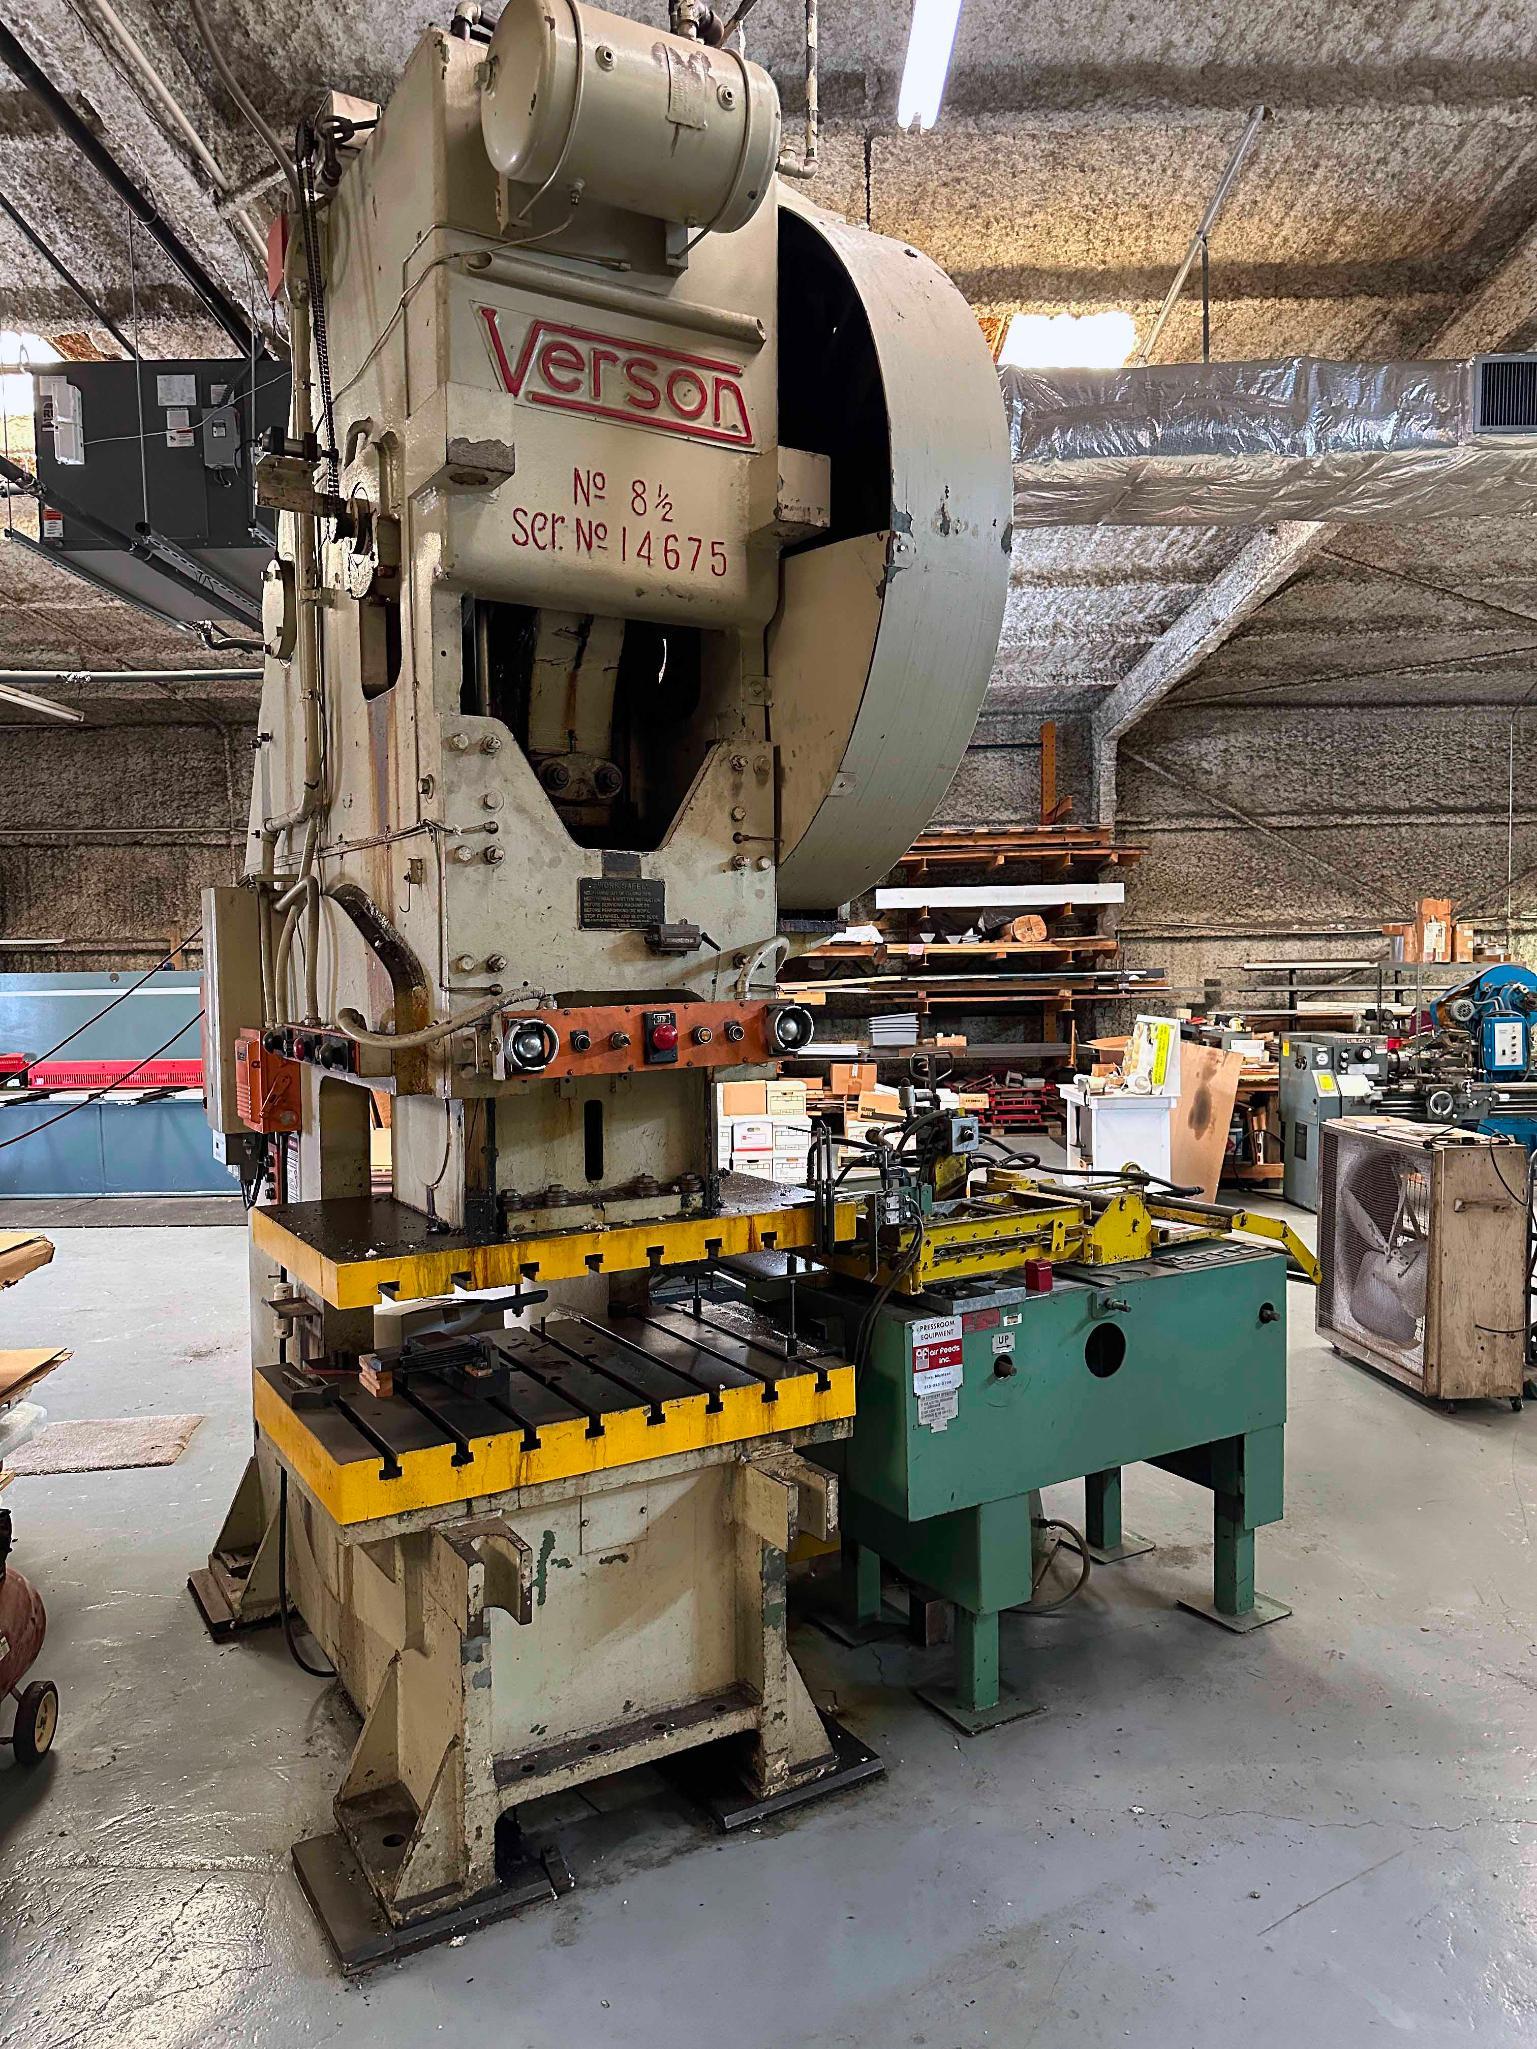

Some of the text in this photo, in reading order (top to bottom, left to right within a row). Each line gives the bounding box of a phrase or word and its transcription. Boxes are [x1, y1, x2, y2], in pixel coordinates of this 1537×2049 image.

[481, 306, 754, 446] Verson
[621, 527, 728, 577] 14675
[919, 1320, 956, 1332] PRESSROOM
[920, 1329, 954, 1341] EQUIPMENT
[998, 1335, 1010, 1345] UP
